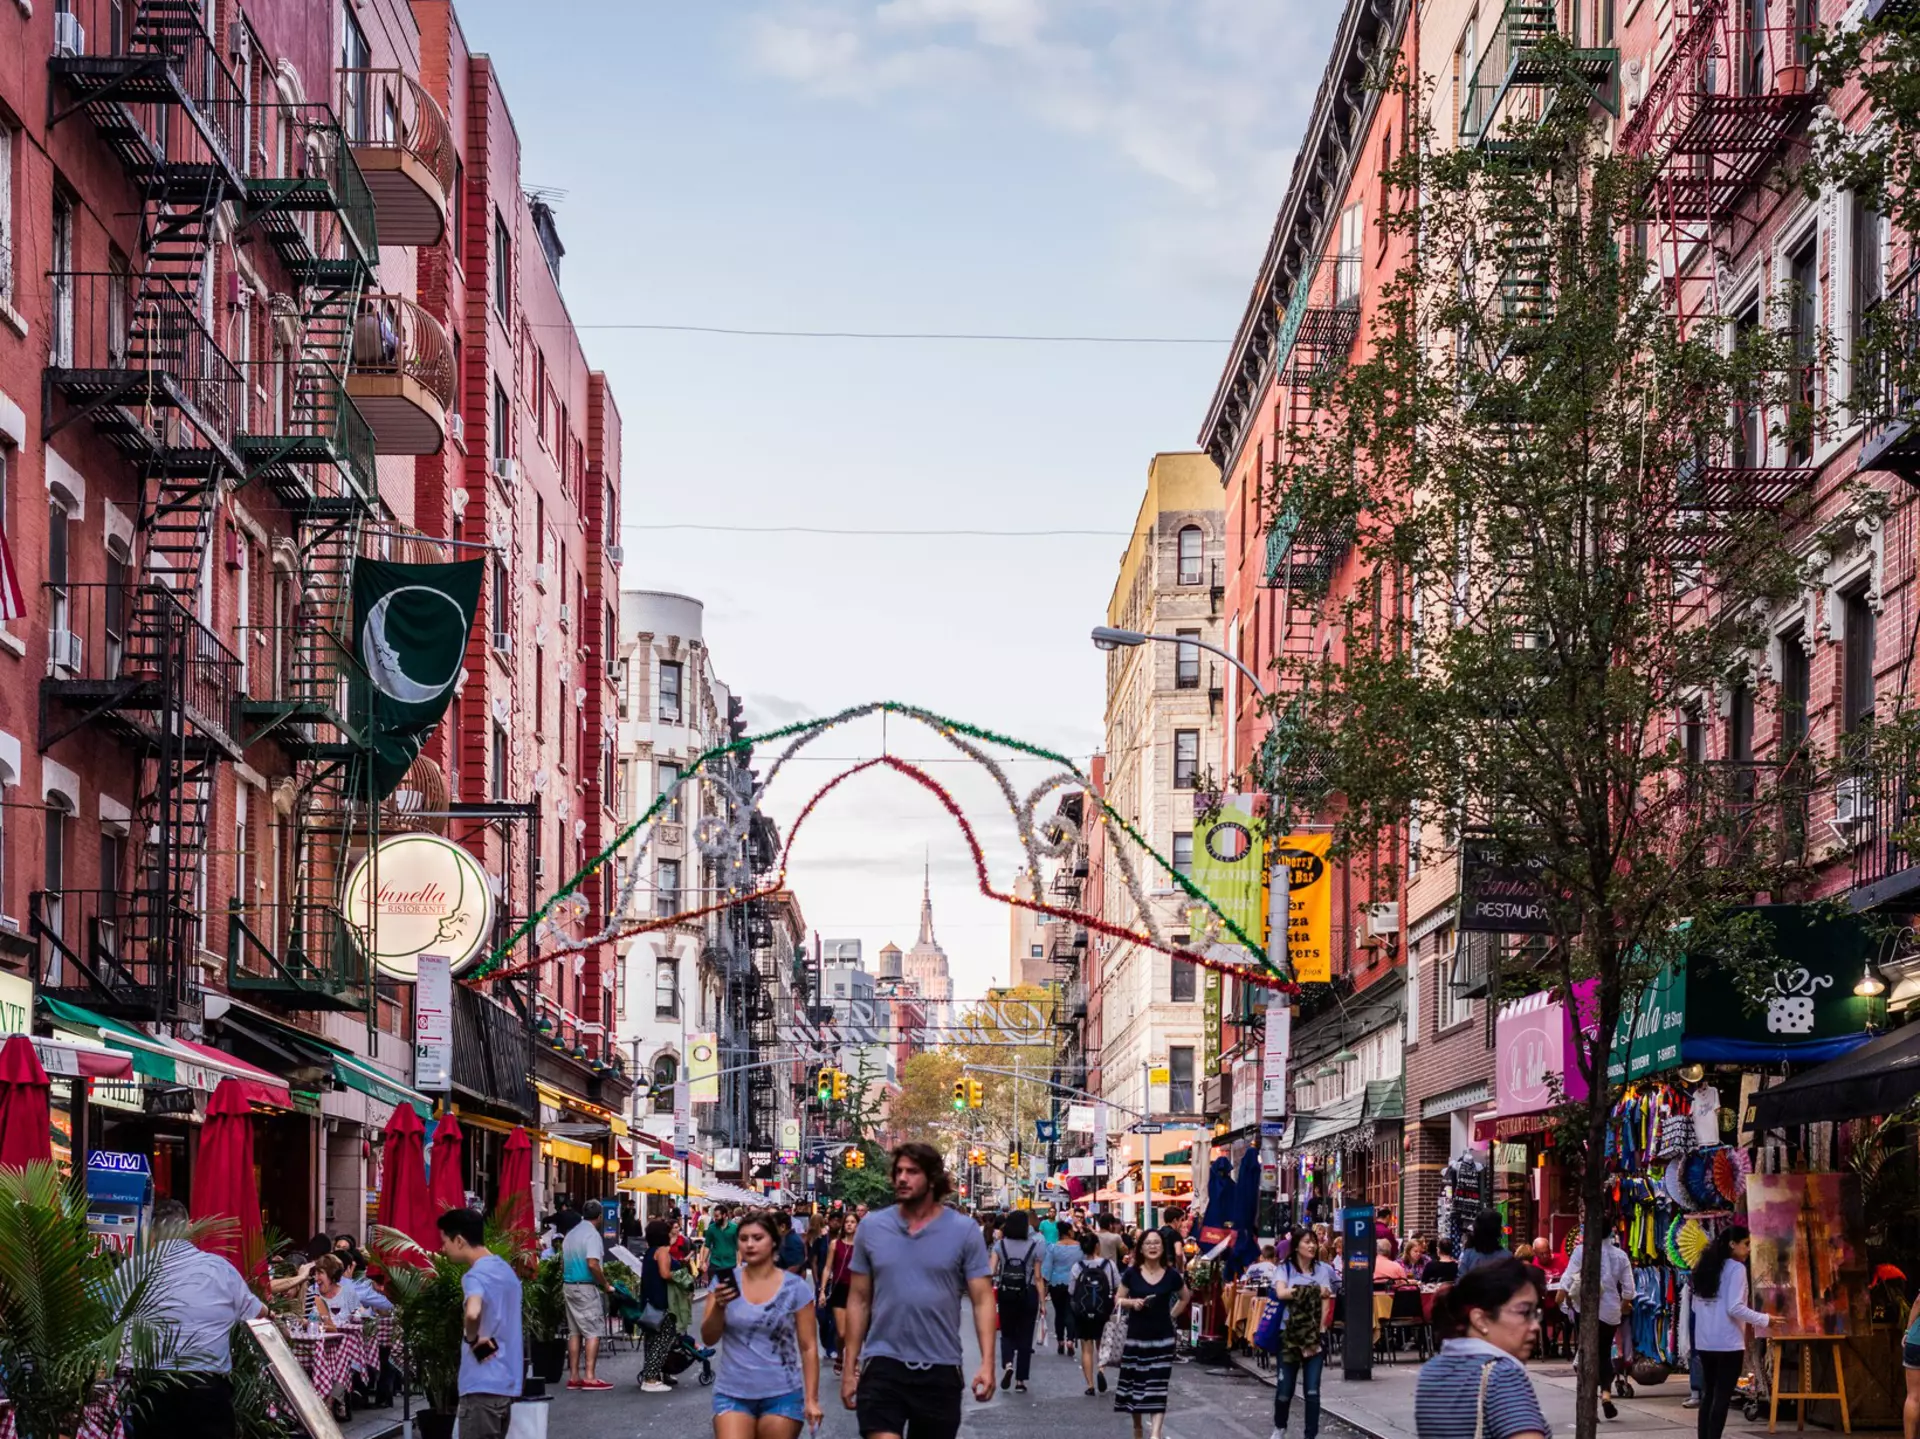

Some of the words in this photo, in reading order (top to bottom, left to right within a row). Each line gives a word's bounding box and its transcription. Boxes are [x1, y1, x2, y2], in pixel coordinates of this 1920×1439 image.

[1263, 854, 1314, 870] lberry
[1196, 868, 1260, 882] WELCOME
[1295, 870, 1315, 884] Bar
[387, 903, 447, 914] RISTORANTE
[1475, 902, 1551, 921] RESTAURA
[418, 1046, 427, 1057] 2
[1657, 1045, 1677, 1062] T-SHIRTS
[1606, 1062, 1626, 1079] HANDBAG
[1631, 1054, 1650, 1071] SOUVENIR
[151, 1094, 190, 1111] ATM
[88, 1150, 141, 1170] ATM
[112, 1193, 140, 1201] Service
[608, 1209, 616, 1220] P
[1354, 1220, 1366, 1237] P
[89, 1231, 136, 1258] TM
